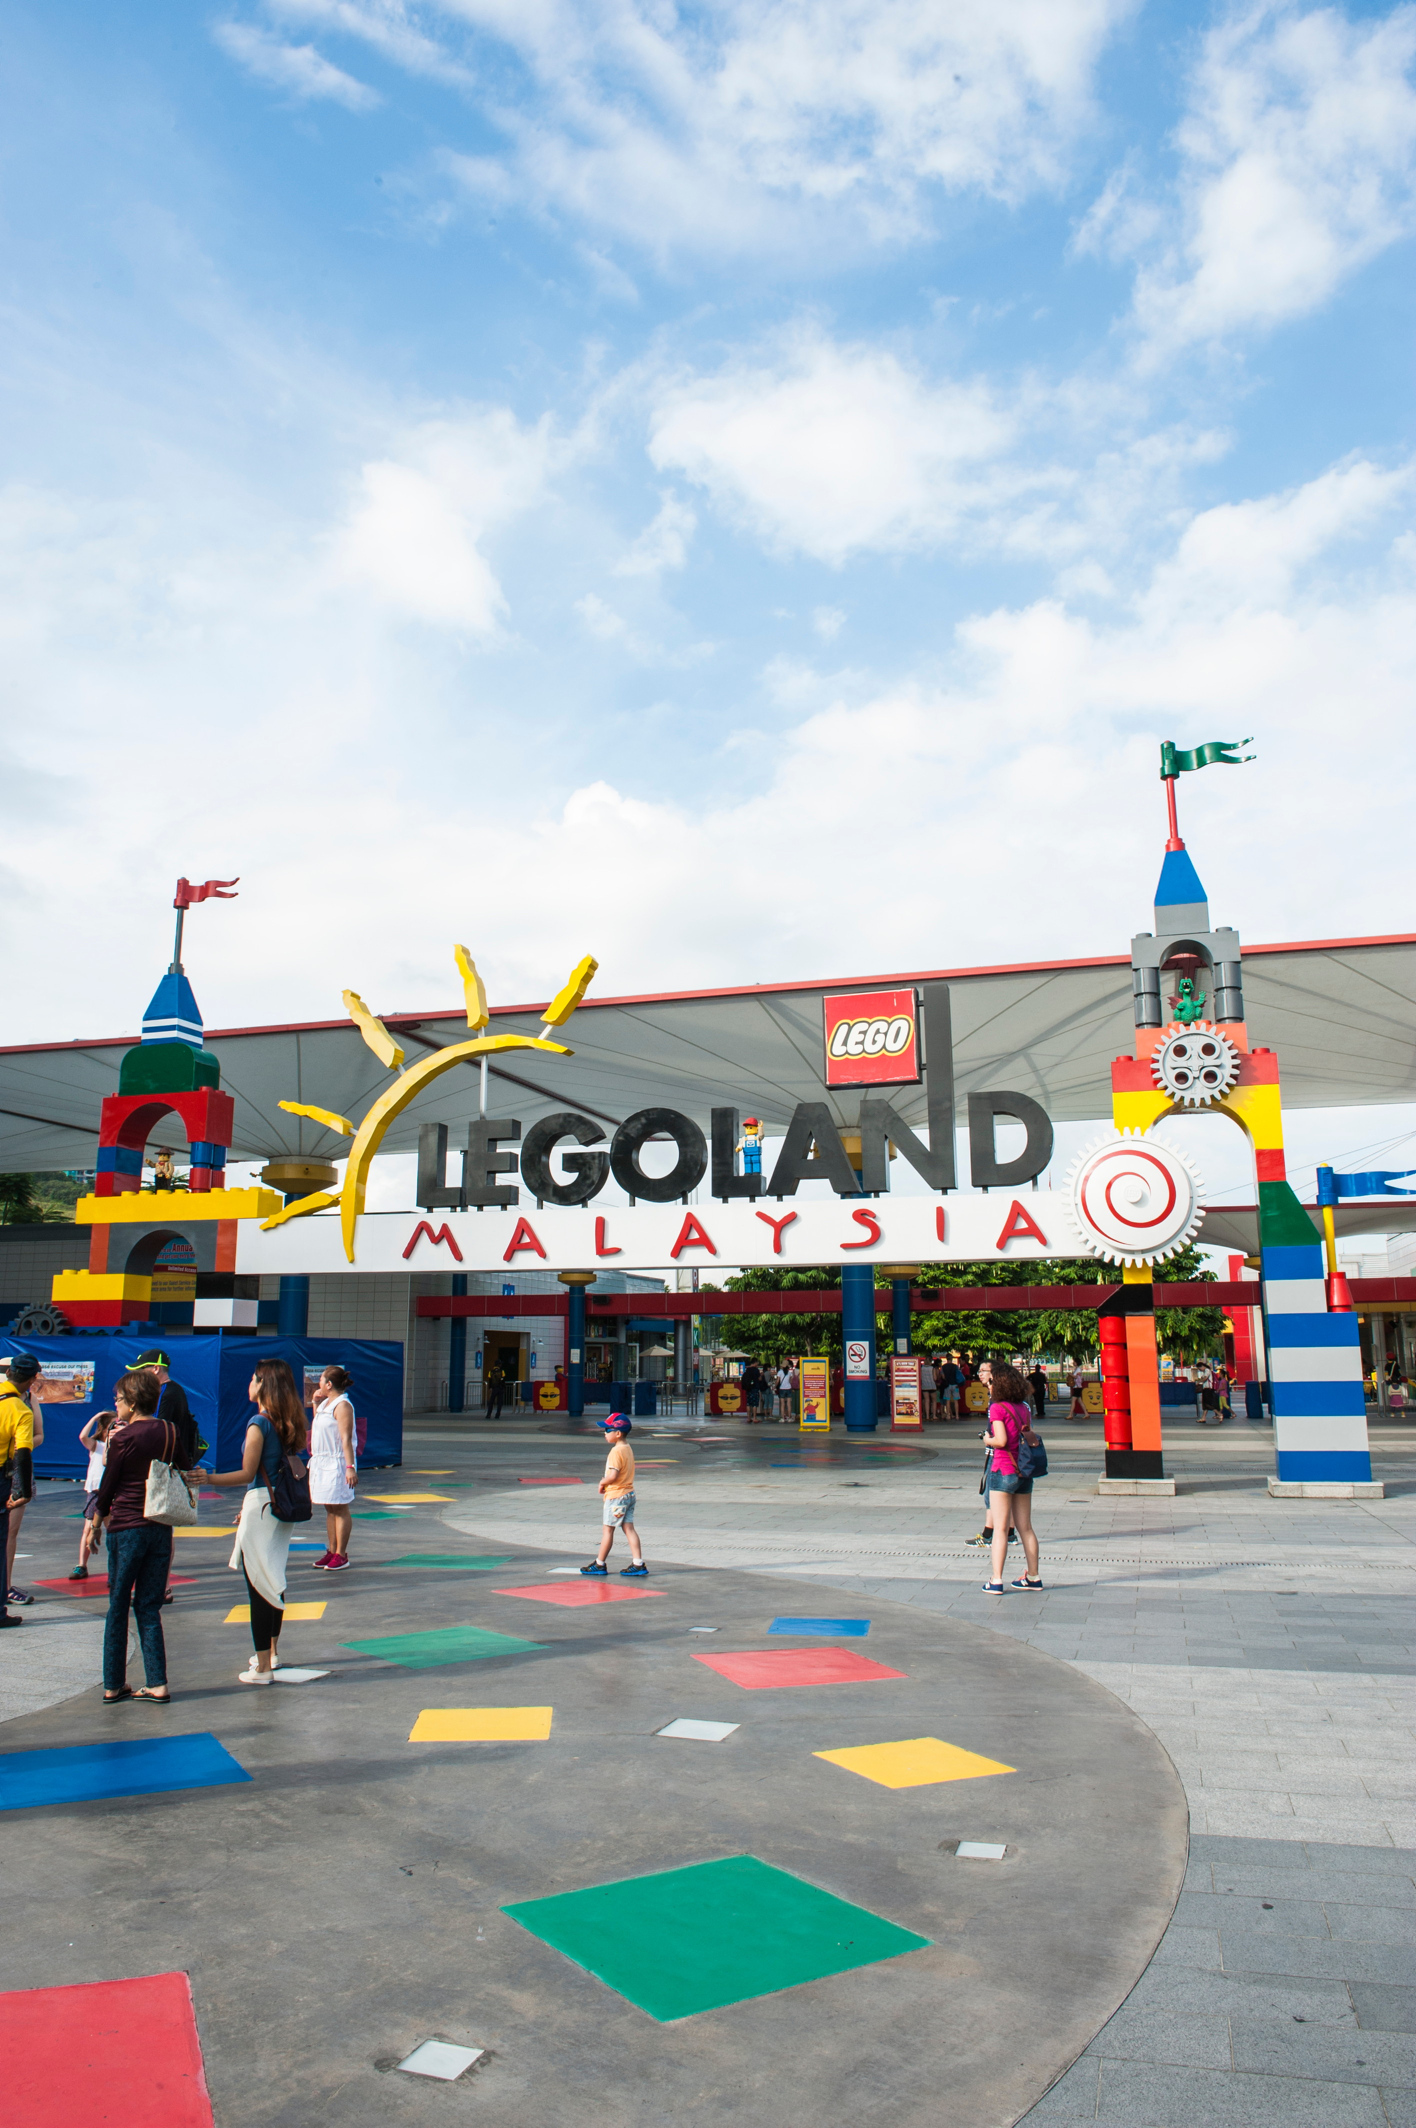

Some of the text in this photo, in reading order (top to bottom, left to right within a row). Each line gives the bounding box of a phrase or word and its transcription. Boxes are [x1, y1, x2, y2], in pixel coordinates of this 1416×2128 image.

[832, 1016, 911, 1059] LEGO
[416, 984, 1054, 1208] LEGOLAND
[172, 1244, 193, 1252] Annua
[401, 1198, 1049, 1262] MALAYSIA
